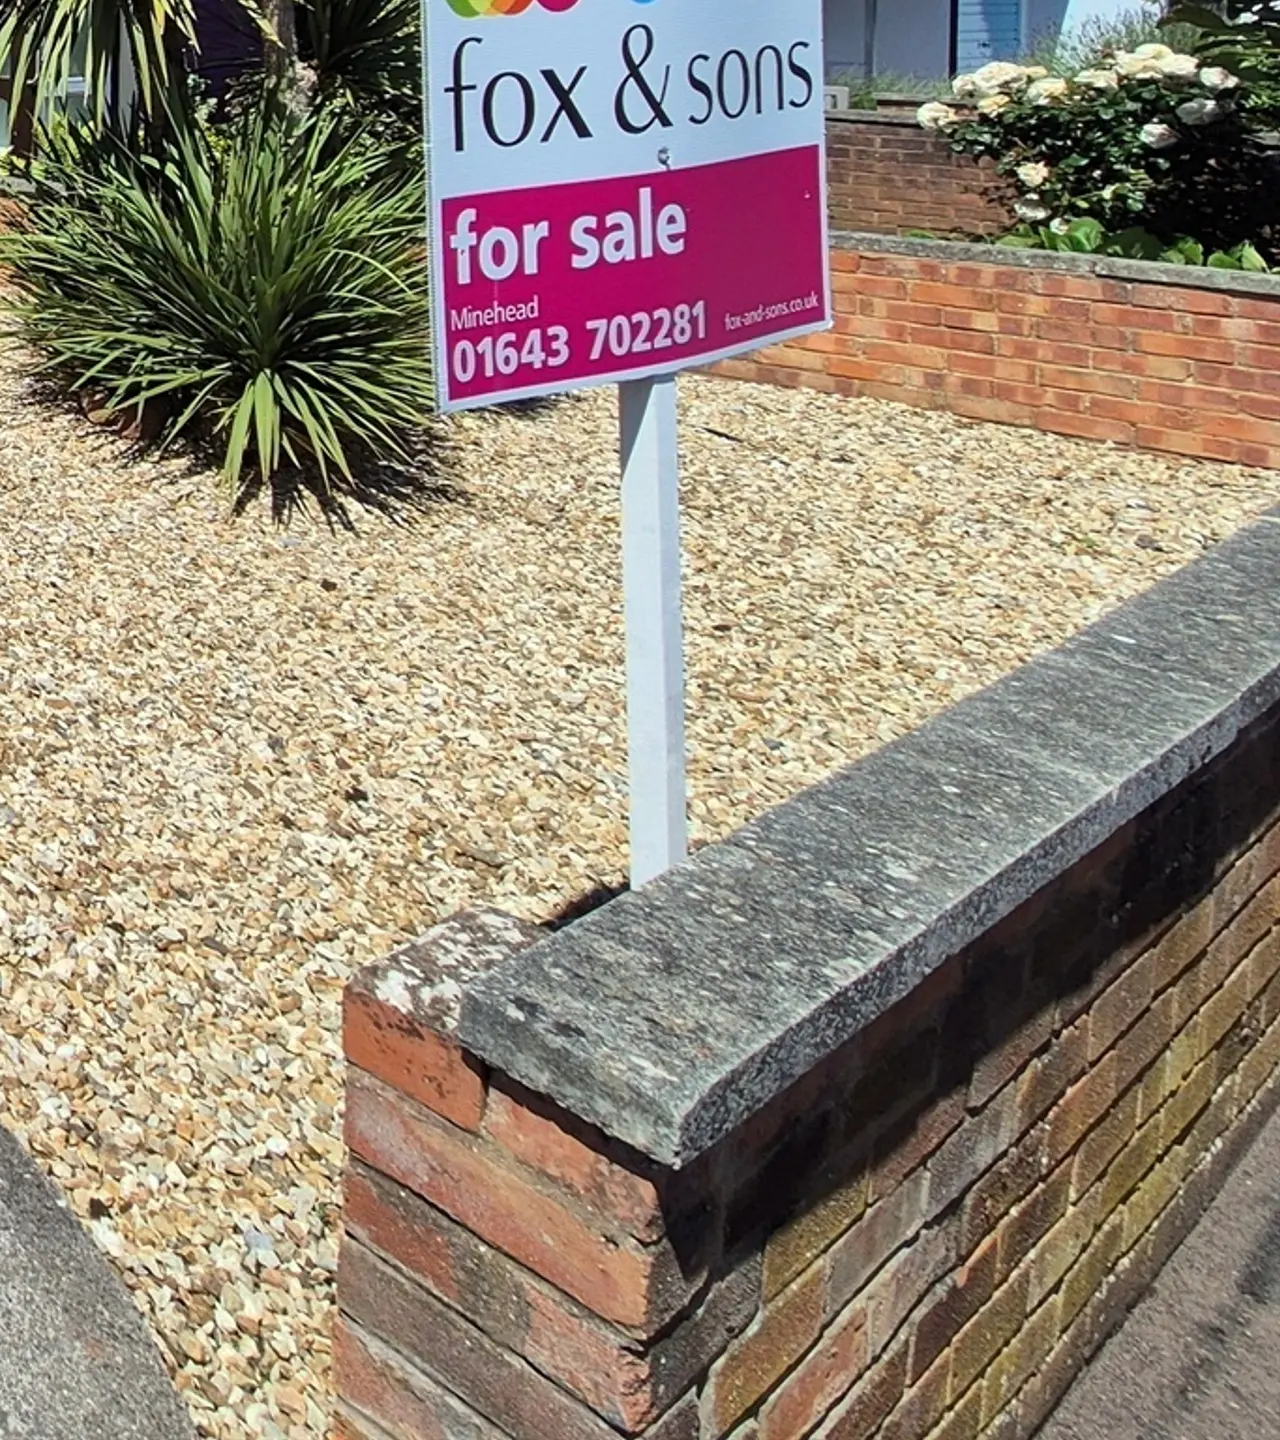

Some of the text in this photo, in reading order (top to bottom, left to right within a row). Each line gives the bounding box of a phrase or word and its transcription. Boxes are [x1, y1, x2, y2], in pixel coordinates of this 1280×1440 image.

[443, 23, 813, 152] fox & sons
[450, 187, 687, 285] for sale
[451, 295, 539, 331] Minehead
[453, 300, 706, 383] 01643 702281
[724, 291, 819, 332] fox-and-sons.co.uk
